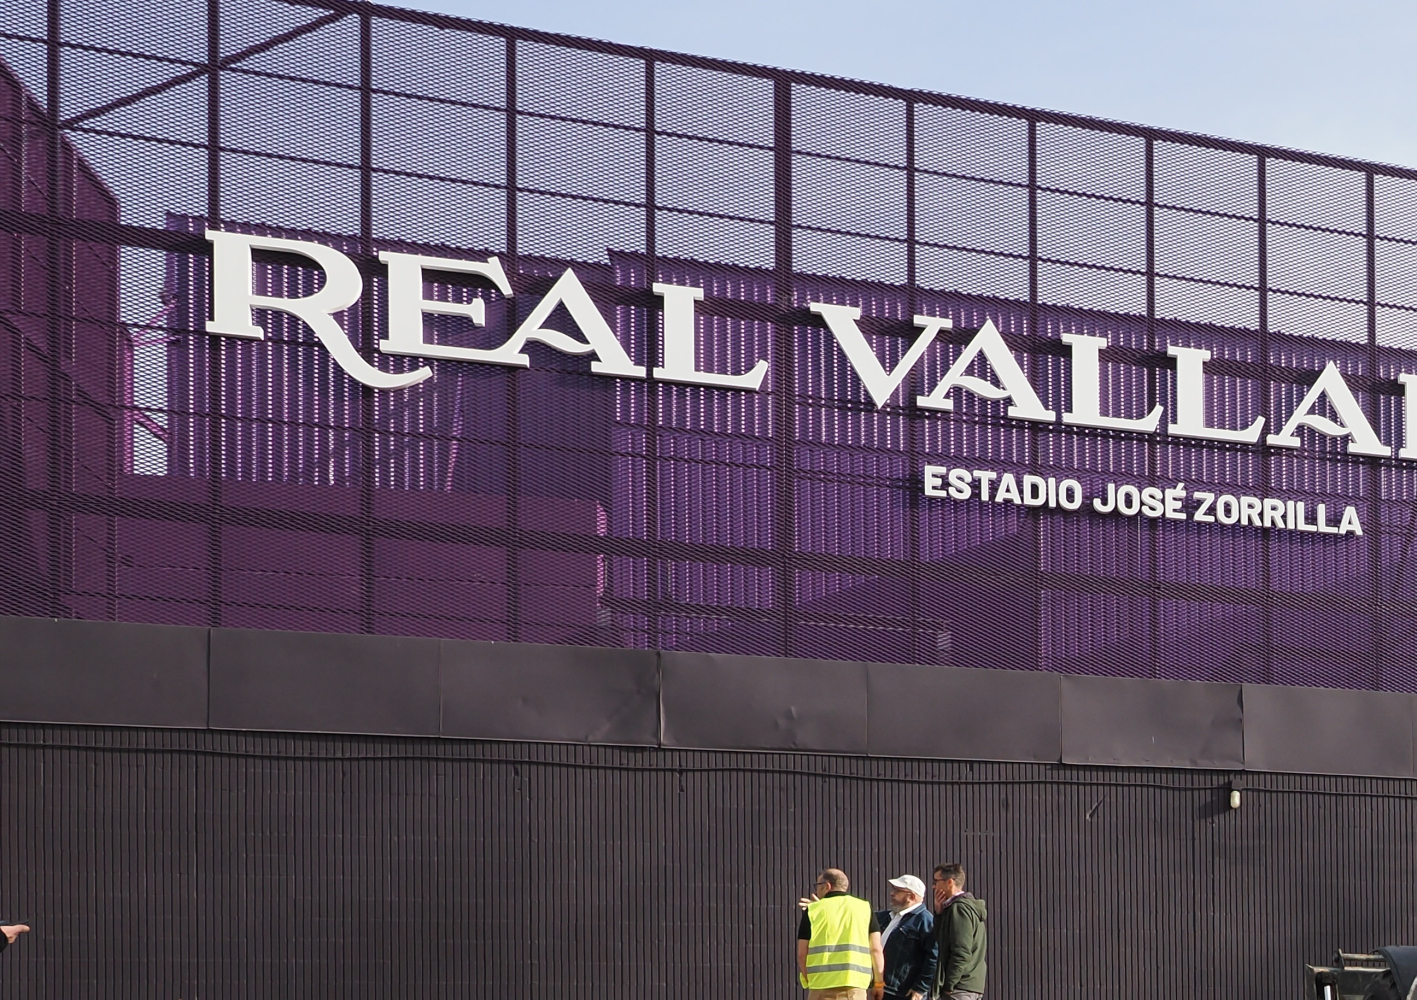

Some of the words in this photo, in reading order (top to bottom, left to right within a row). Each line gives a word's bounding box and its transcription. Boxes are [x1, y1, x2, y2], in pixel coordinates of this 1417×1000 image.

[205, 229, 769, 391] REAL
[922, 465, 1083, 512] ESTADIO
[1092, 482, 1187, 520] JOSÉ
[1193, 491, 1364, 536] ZORRILLA
